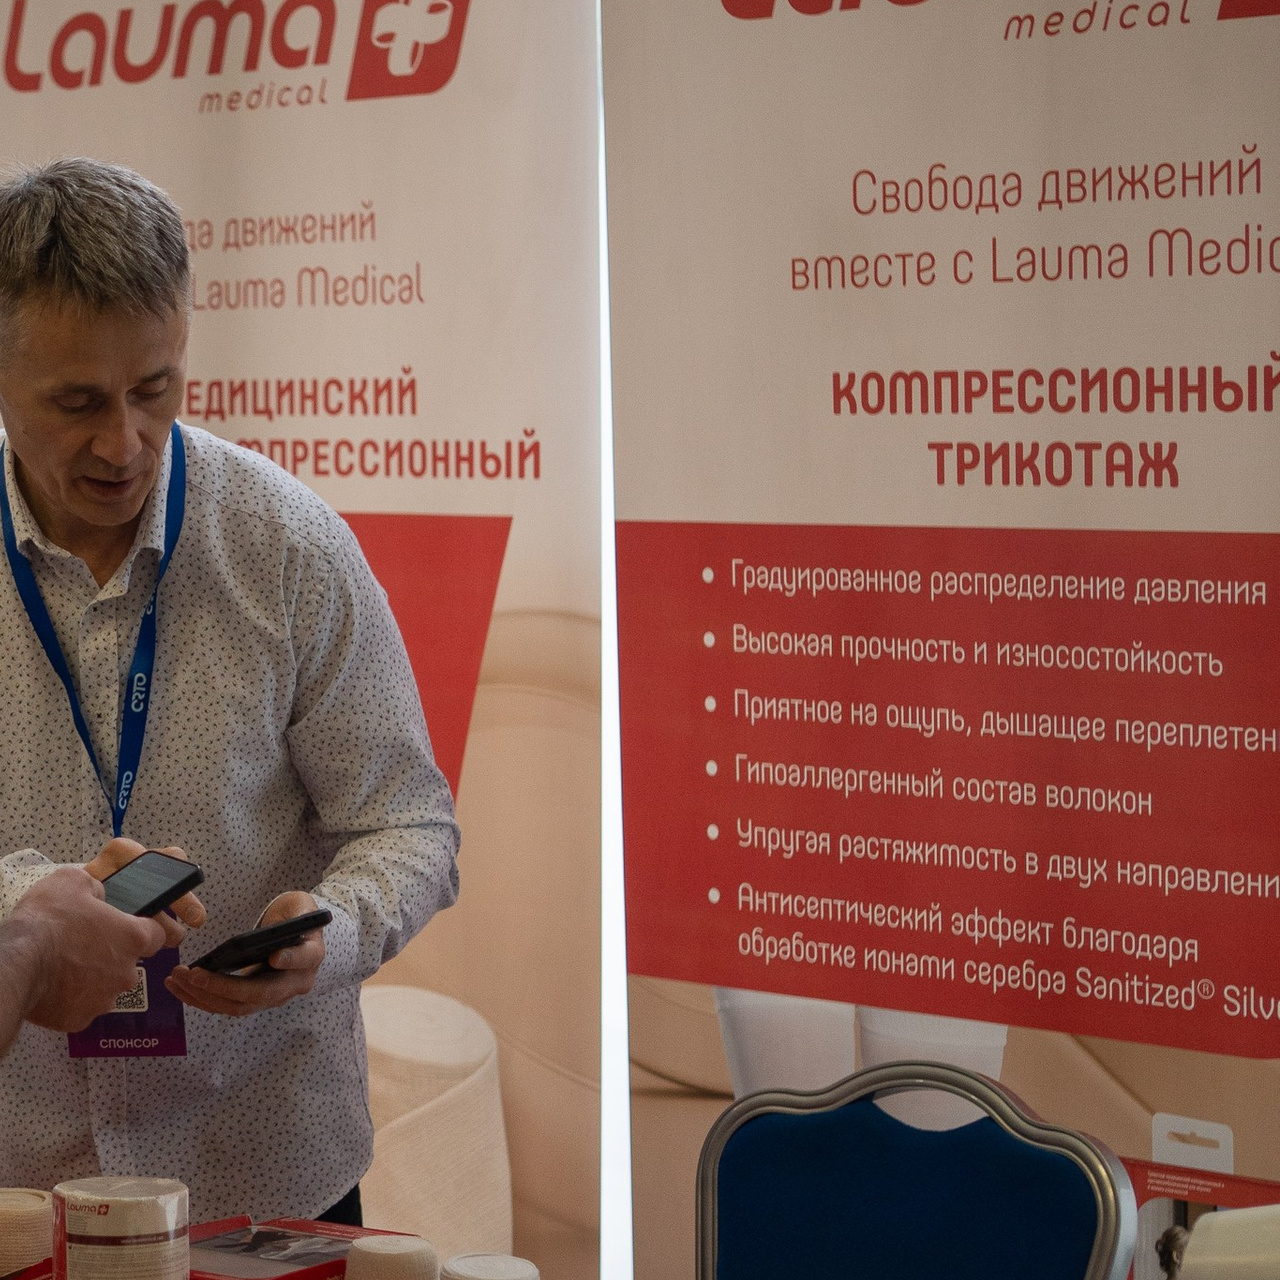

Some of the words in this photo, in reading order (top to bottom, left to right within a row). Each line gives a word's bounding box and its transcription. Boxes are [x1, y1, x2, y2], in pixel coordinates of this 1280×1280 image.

[198, 79, 328, 114] medical
[851, 162, 1023, 217] Свобода
[1036, 144, 1262, 212] движений
[221, 201, 377, 252] движений
[296, 262, 426, 309] Medical
[790, 250, 937, 292] вместе
[952, 249, 974, 286] с
[990, 236, 1129, 284] Lauma
[181, 366, 417, 421] ЕДИЦИНСКИЙ
[237, 429, 541, 480] ПРЕССИОННЫЙ
[927, 441, 1179, 488] ТРИКОТАЖ
[731, 558, 922, 599] Градуированное
[930, 570, 1126, 603] распределение
[1133, 578, 1267, 606] давления
[732, 623, 833, 657] Высокая
[840, 635, 966, 666] прочность
[973, 641, 988, 665] и
[996, 641, 1224, 677] износостойкость
[733, 688, 843, 726] Приятное
[850, 702, 878, 727] на
[885, 704, 972, 738] ощупь,
[979, 710, 1106, 743] дышащее
[1115, 719, 1280, 753] переплетен
[735, 753, 944, 799] Гипоаллергенный
[952, 776, 1037, 806] состав
[1045, 784, 1152, 816] волокон
[736, 817, 831, 859] Упругая
[838, 834, 1017, 874] растяжимость
[1025, 852, 1039, 875] в
[1046, 854, 1108, 889] двух
[737, 882, 943, 928] Антисептический
[950, 906, 1054, 948] эффект
[1062, 916, 1199, 968] благодаря
[738, 926, 856, 968] обработке
[864, 947, 955, 981] ионами
[963, 959, 1066, 1000] серебра
[1223, 984, 1280, 1020] Silv
[99, 1037, 160, 1049] СПОНСОР
